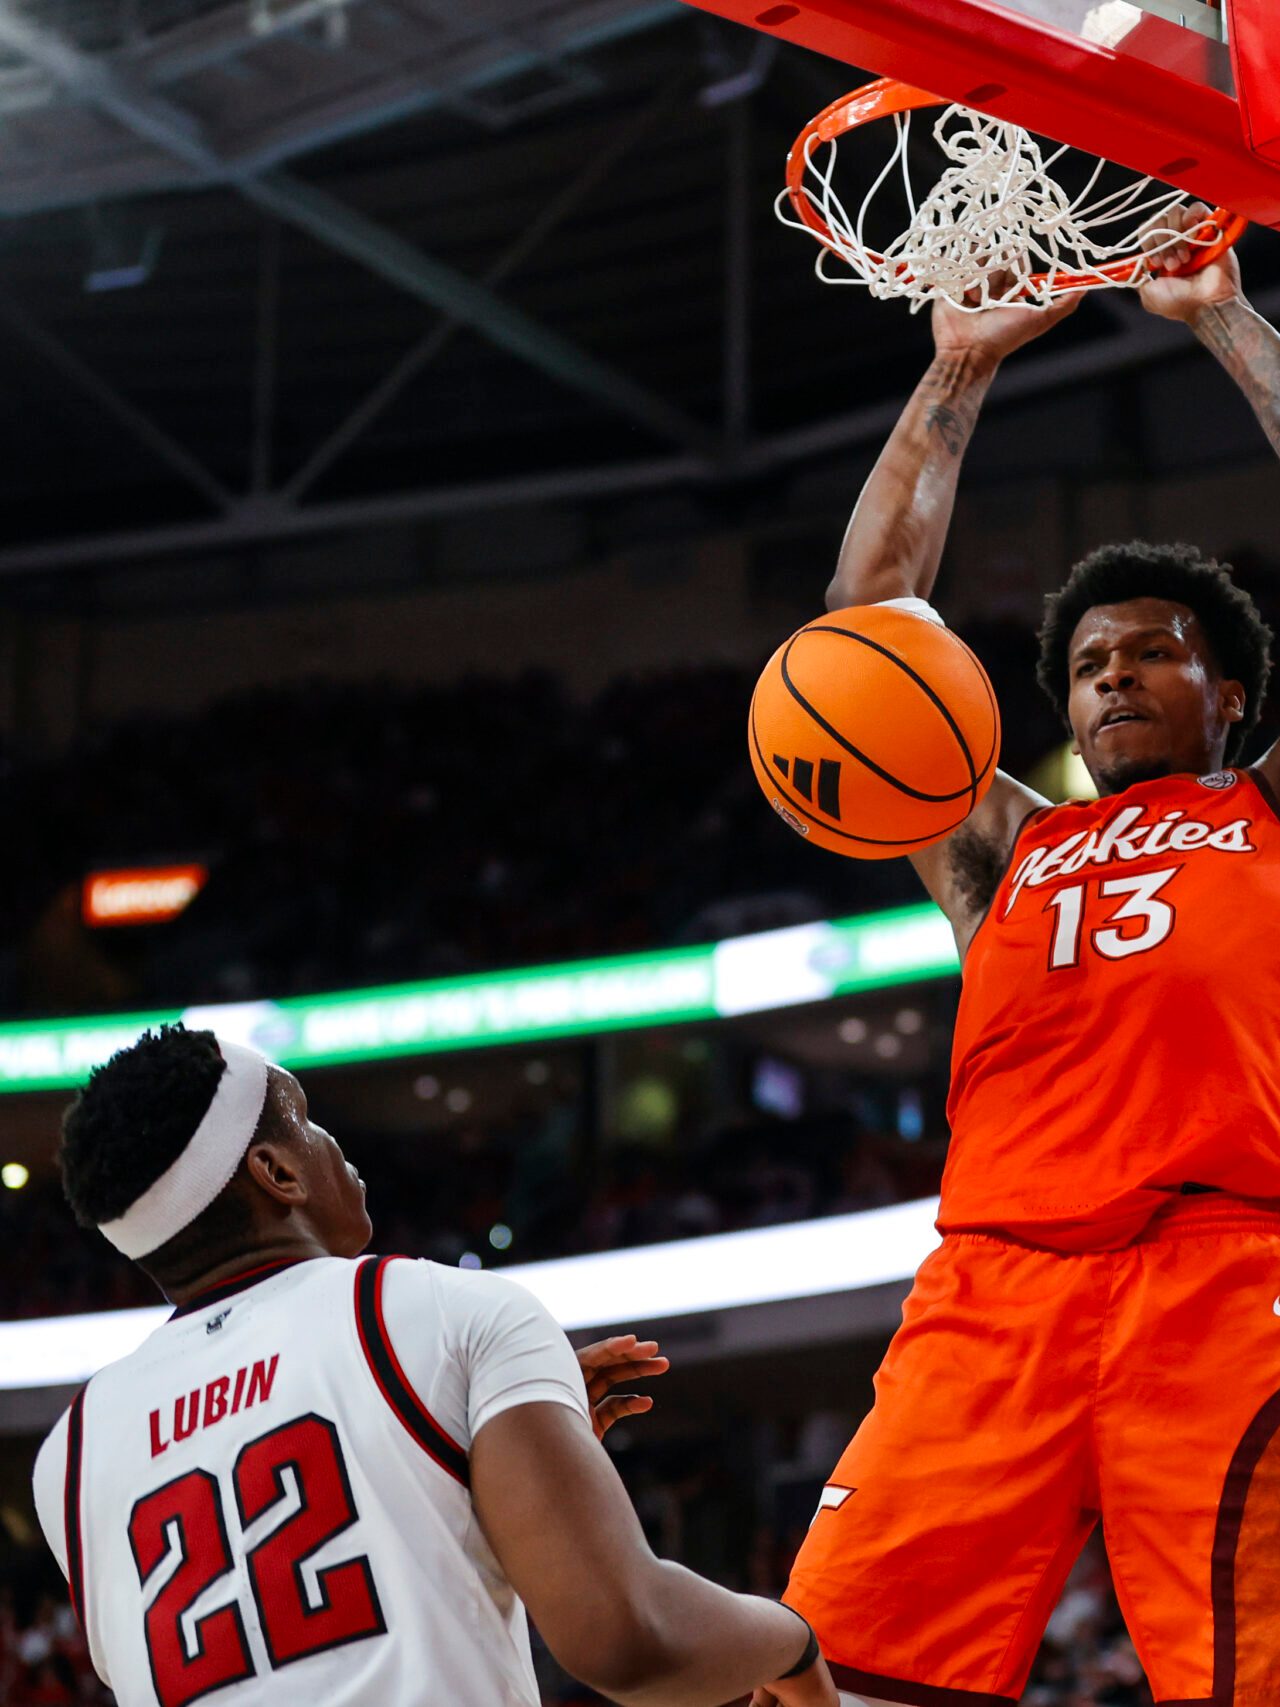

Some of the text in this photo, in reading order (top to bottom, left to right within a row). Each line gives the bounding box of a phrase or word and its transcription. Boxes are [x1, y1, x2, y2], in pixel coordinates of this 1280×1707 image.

[1003, 806, 1256, 922] Hokies
[1043, 863, 1186, 972] 13
[149, 1353, 281, 1459] LUBIN
[128, 1411, 388, 1707] 22
